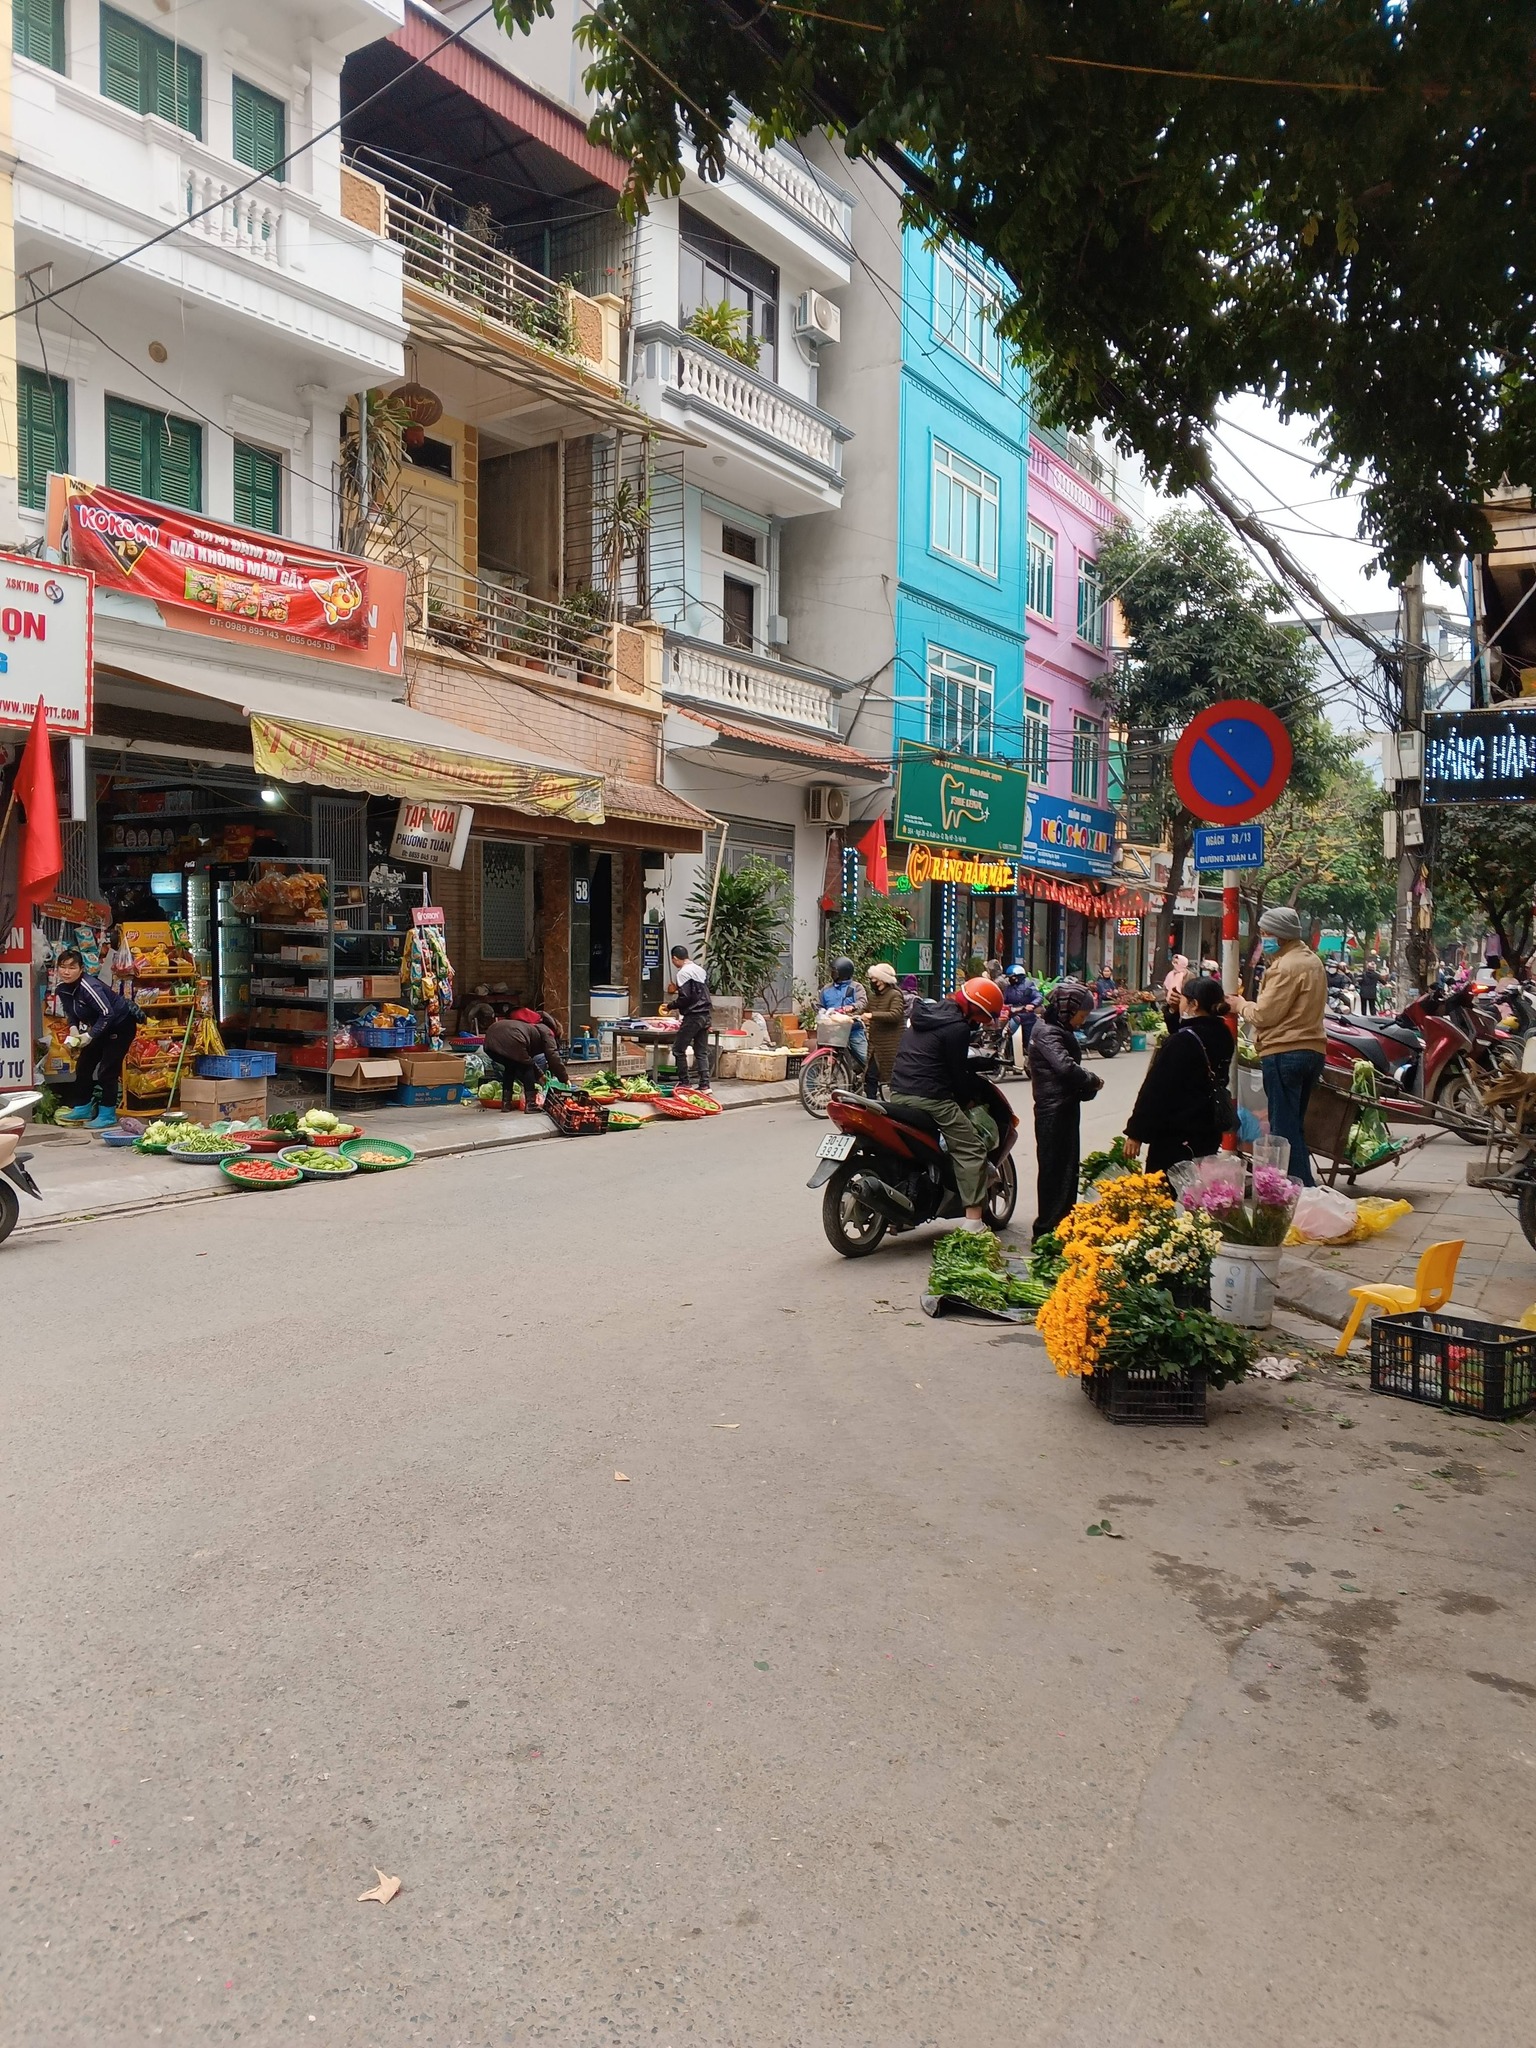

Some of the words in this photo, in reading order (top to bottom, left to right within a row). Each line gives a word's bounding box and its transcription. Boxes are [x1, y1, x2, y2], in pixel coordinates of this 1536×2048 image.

[80, 504, 159, 549] KOKOMI
[114, 540, 139, 557] 75
[197, 549, 245, 573] KHÔNG
[6, 578, 40, 594] XSKTMB
[0, 607, 46, 642] ỌN
[209, 617, 224, 628] ĐT:
[225, 621, 247, 633] 0989
[248, 625, 264, 636] 895
[266, 630, 279, 640] 143
[285, 634, 306, 645] 0855
[306, 639, 322, 649] 045
[0, 699, 80, 721] WW.VIEOTT.COM
[404, 804, 427, 833] TẠP
[1041, 815, 1067, 846] NGÔI
[1205, 833, 1225, 847] NGÁCH
[1200, 853, 1225, 864] ĐƯỜNG
[1225, 851, 1247, 862] XUÂN
[1247, 852, 1258, 861] LA
[576, 881, 588, 900] 58
